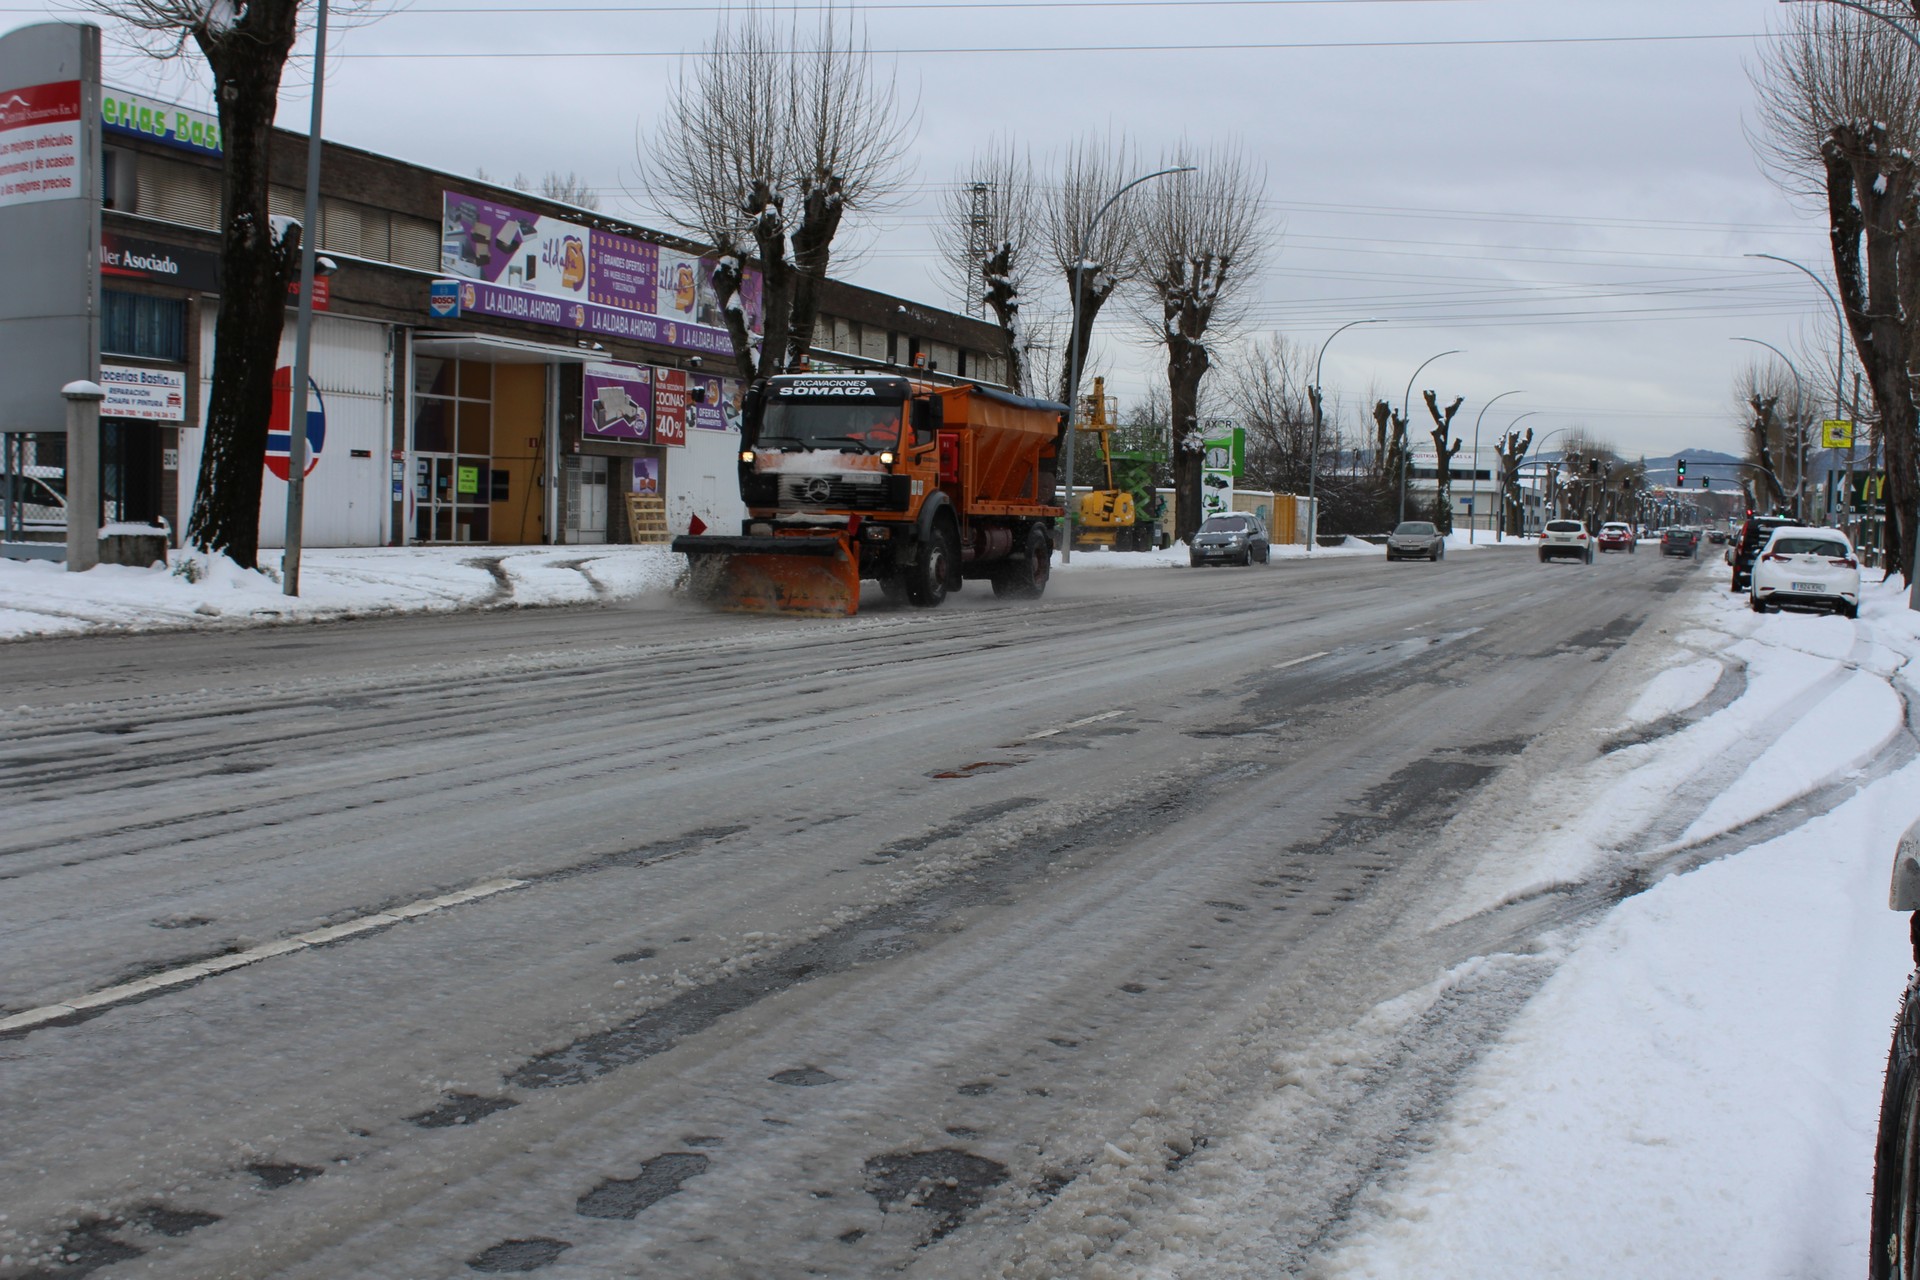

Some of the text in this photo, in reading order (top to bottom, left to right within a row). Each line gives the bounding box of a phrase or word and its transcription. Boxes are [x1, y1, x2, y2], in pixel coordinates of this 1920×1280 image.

[10, 138, 35, 154] mejores
[35, 156, 45, 170] de
[15, 179, 41, 195] mejores
[42, 174, 72, 193] precios
[123, 249, 178, 275] Asociado
[603, 253, 625, 269] GRANDES
[625, 258, 646, 274] OFERTAS
[430, 295, 457, 305] BOSCH
[484, 290, 496, 311] LA
[496, 293, 530, 317] ALDABA
[529, 299, 561, 322] AHORRO
[592, 310, 601, 330] LA
[602, 312, 629, 335] ALDABA
[629, 318, 657, 340] AHORRO
[682, 328, 691, 345] LA
[691, 330, 715, 350] ALDABA
[109, 387, 151, 397] REPARACIÓN
[779, 387, 876, 396] SOMAGA
[107, 397, 130, 405] CHAPA
[136, 398, 163, 407] PINTURA
[698, 407, 721, 419] OFERTAS
